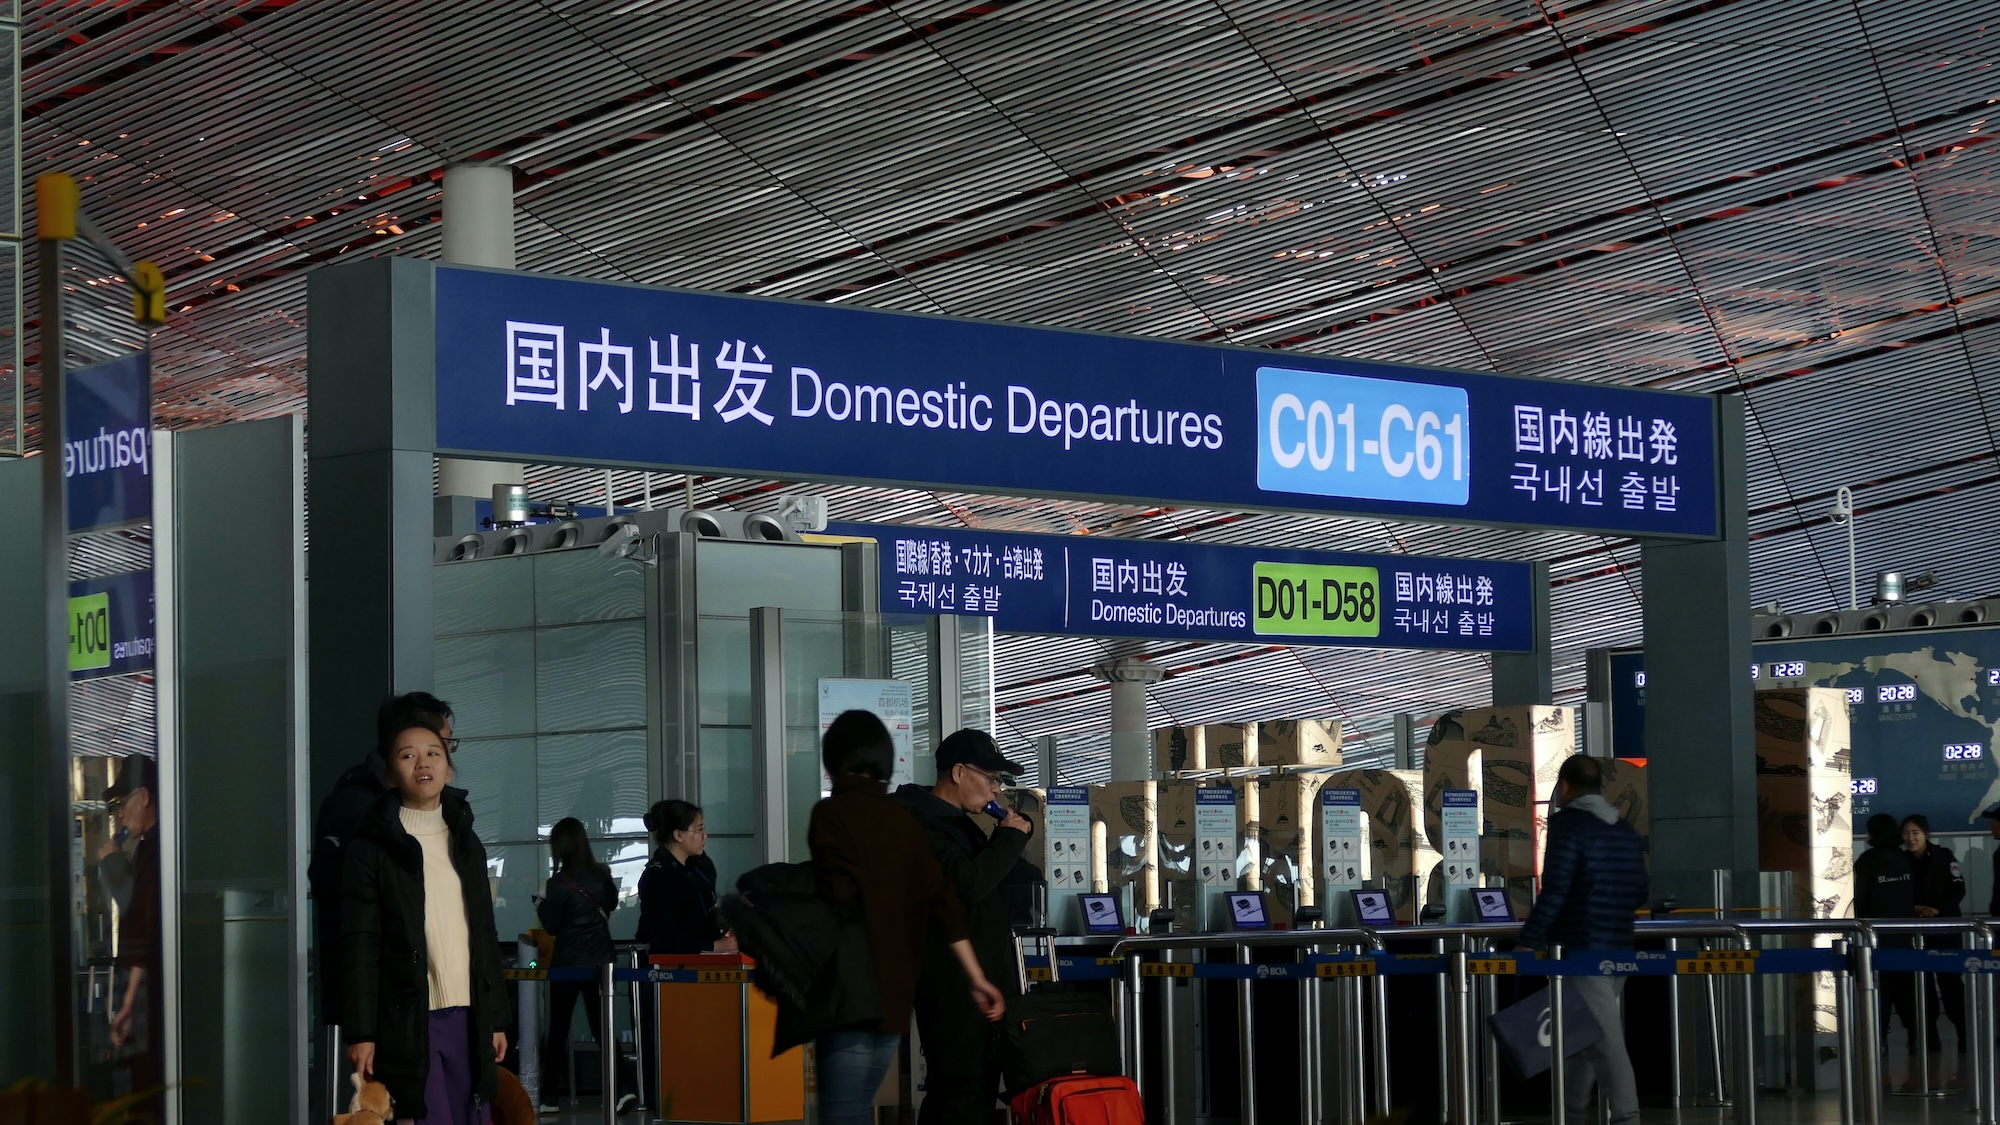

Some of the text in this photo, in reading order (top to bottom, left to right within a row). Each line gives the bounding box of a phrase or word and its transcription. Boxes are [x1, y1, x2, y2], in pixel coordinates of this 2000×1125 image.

[505, 320, 775, 426] 国内出发
[791, 366, 1223, 450] Domestic Departures
[1269, 393, 1462, 481] C01-C61
[1514, 404, 1679, 466] 国内線出発
[1510, 462, 1681, 512] 국내선 출발
[1091, 557, 1189, 597] 国内出发
[1395, 571, 1494, 606] 国内線出発
[897, 580, 1002, 612] 국제선 출발
[1257, 576, 1376, 623] D01-D58
[1091, 599, 1246, 631] Domestic Departures
[1393, 607, 1495, 636] 국내선 출발
[704, 972, 742, 980] 应急专用
[1145, 965, 1186, 976] 应急专用
[1269, 967, 1288, 976] BCIA
[1324, 963, 1369, 976] 应急专用
[1469, 961, 1507, 973] 急专用
[1616, 962, 1640, 972] BCIA
[1687, 961, 1745, 973] 应急专用
